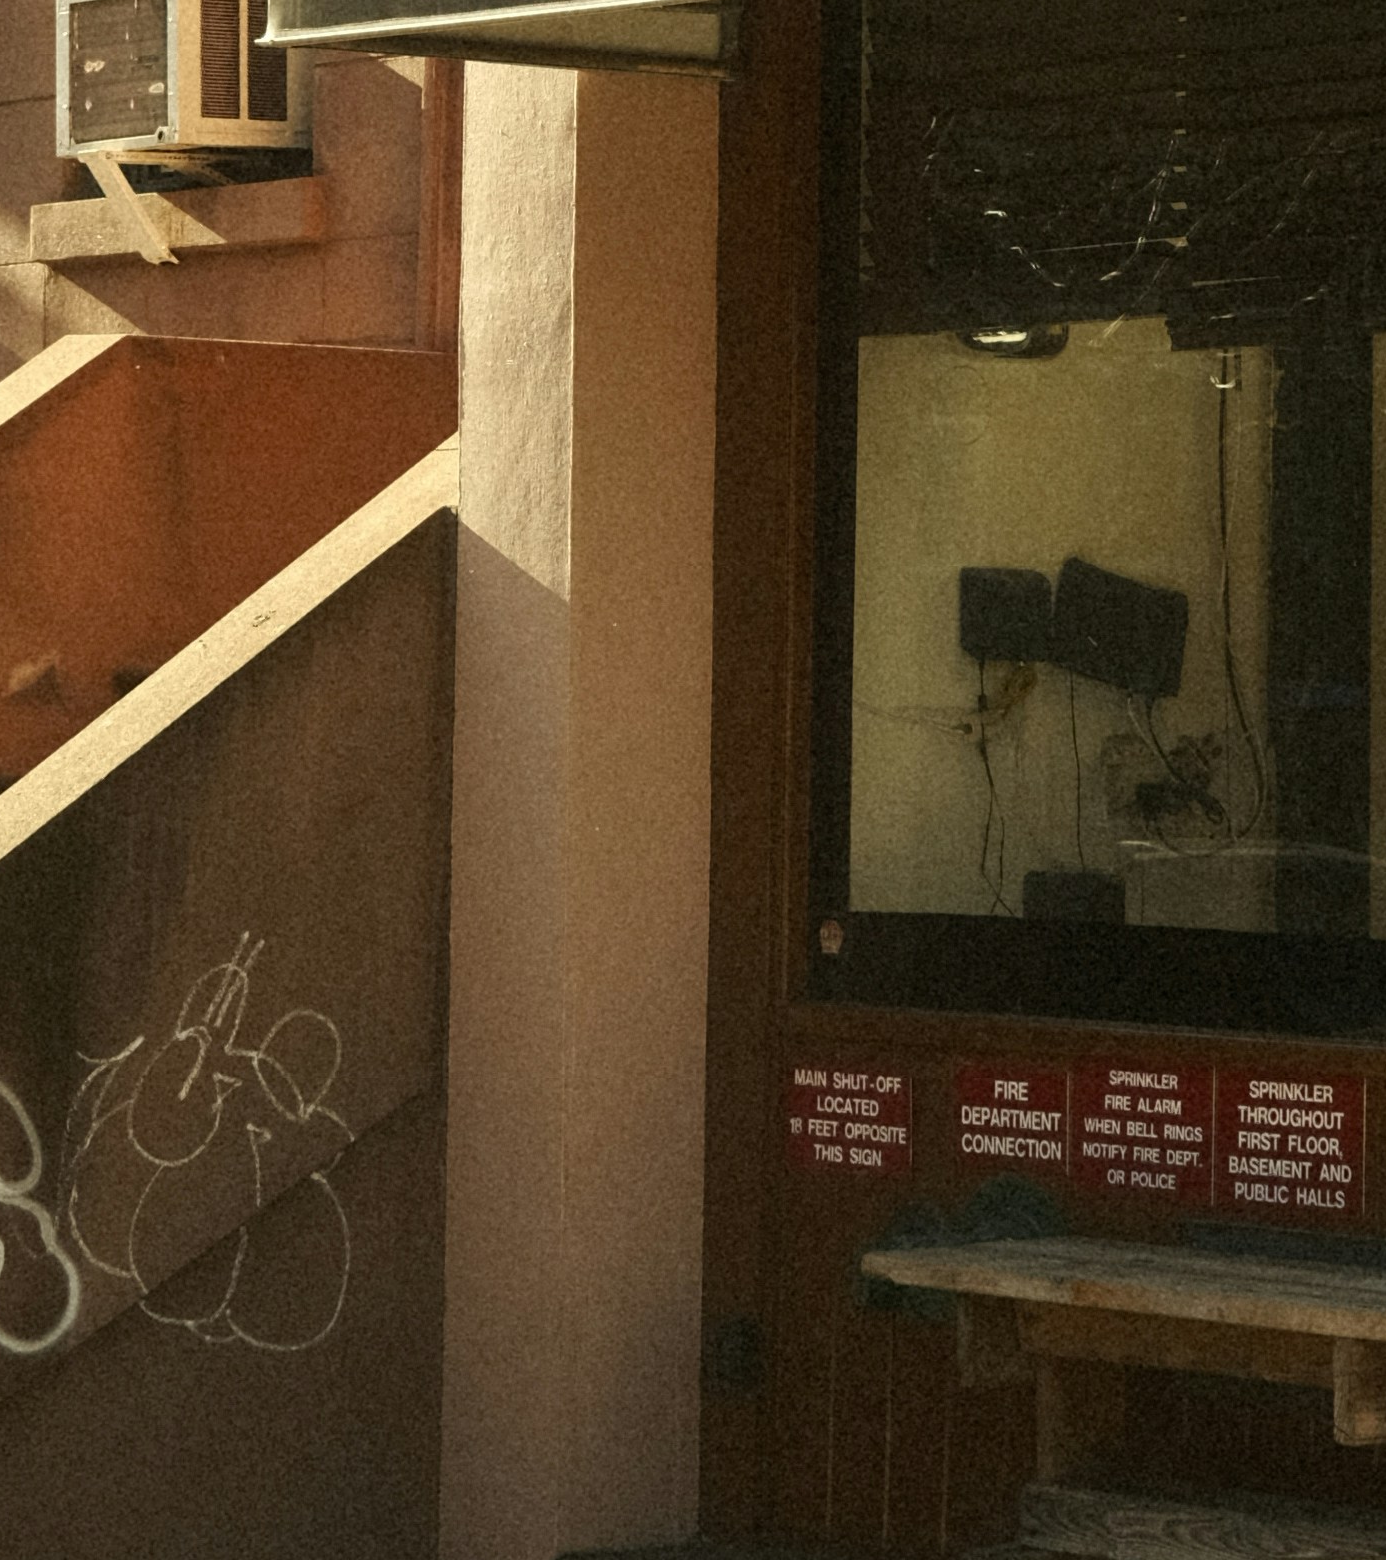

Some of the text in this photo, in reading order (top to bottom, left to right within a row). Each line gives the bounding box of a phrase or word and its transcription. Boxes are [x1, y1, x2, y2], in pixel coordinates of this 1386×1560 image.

[794, 1068, 827, 1087] MAIN
[1109, 1070, 1178, 1090] SPRINKLER
[994, 1080, 1029, 1101] FIRE
[1249, 1080, 1333, 1103] SPRINKLER
[816, 1095, 879, 1117] LOCATED
[1104, 1094, 1182, 1115] FIRE ALARM
[961, 1105, 1062, 1132] DEPARTMENT
[1084, 1117, 1203, 1142] WHEN BELL RINGS
[1237, 1105, 1344, 1130] THROUGHOUT
[808, 1118, 838, 1137] FEET
[844, 1122, 907, 1144] OPPOSITE
[814, 1143, 882, 1167] THIS SIGN
[961, 1133, 1062, 1160] CONNECTION
[1083, 1142, 1203, 1168] NOTIFY FIRE DEPT.
[1238, 1131, 1343, 1160] FIRST FLOOR,
[1107, 1168, 1176, 1190] OR POLICE
[1228, 1155, 1352, 1183] BASEMENT AND
[1235, 1181, 1346, 1209] PUBLIC HALLS
